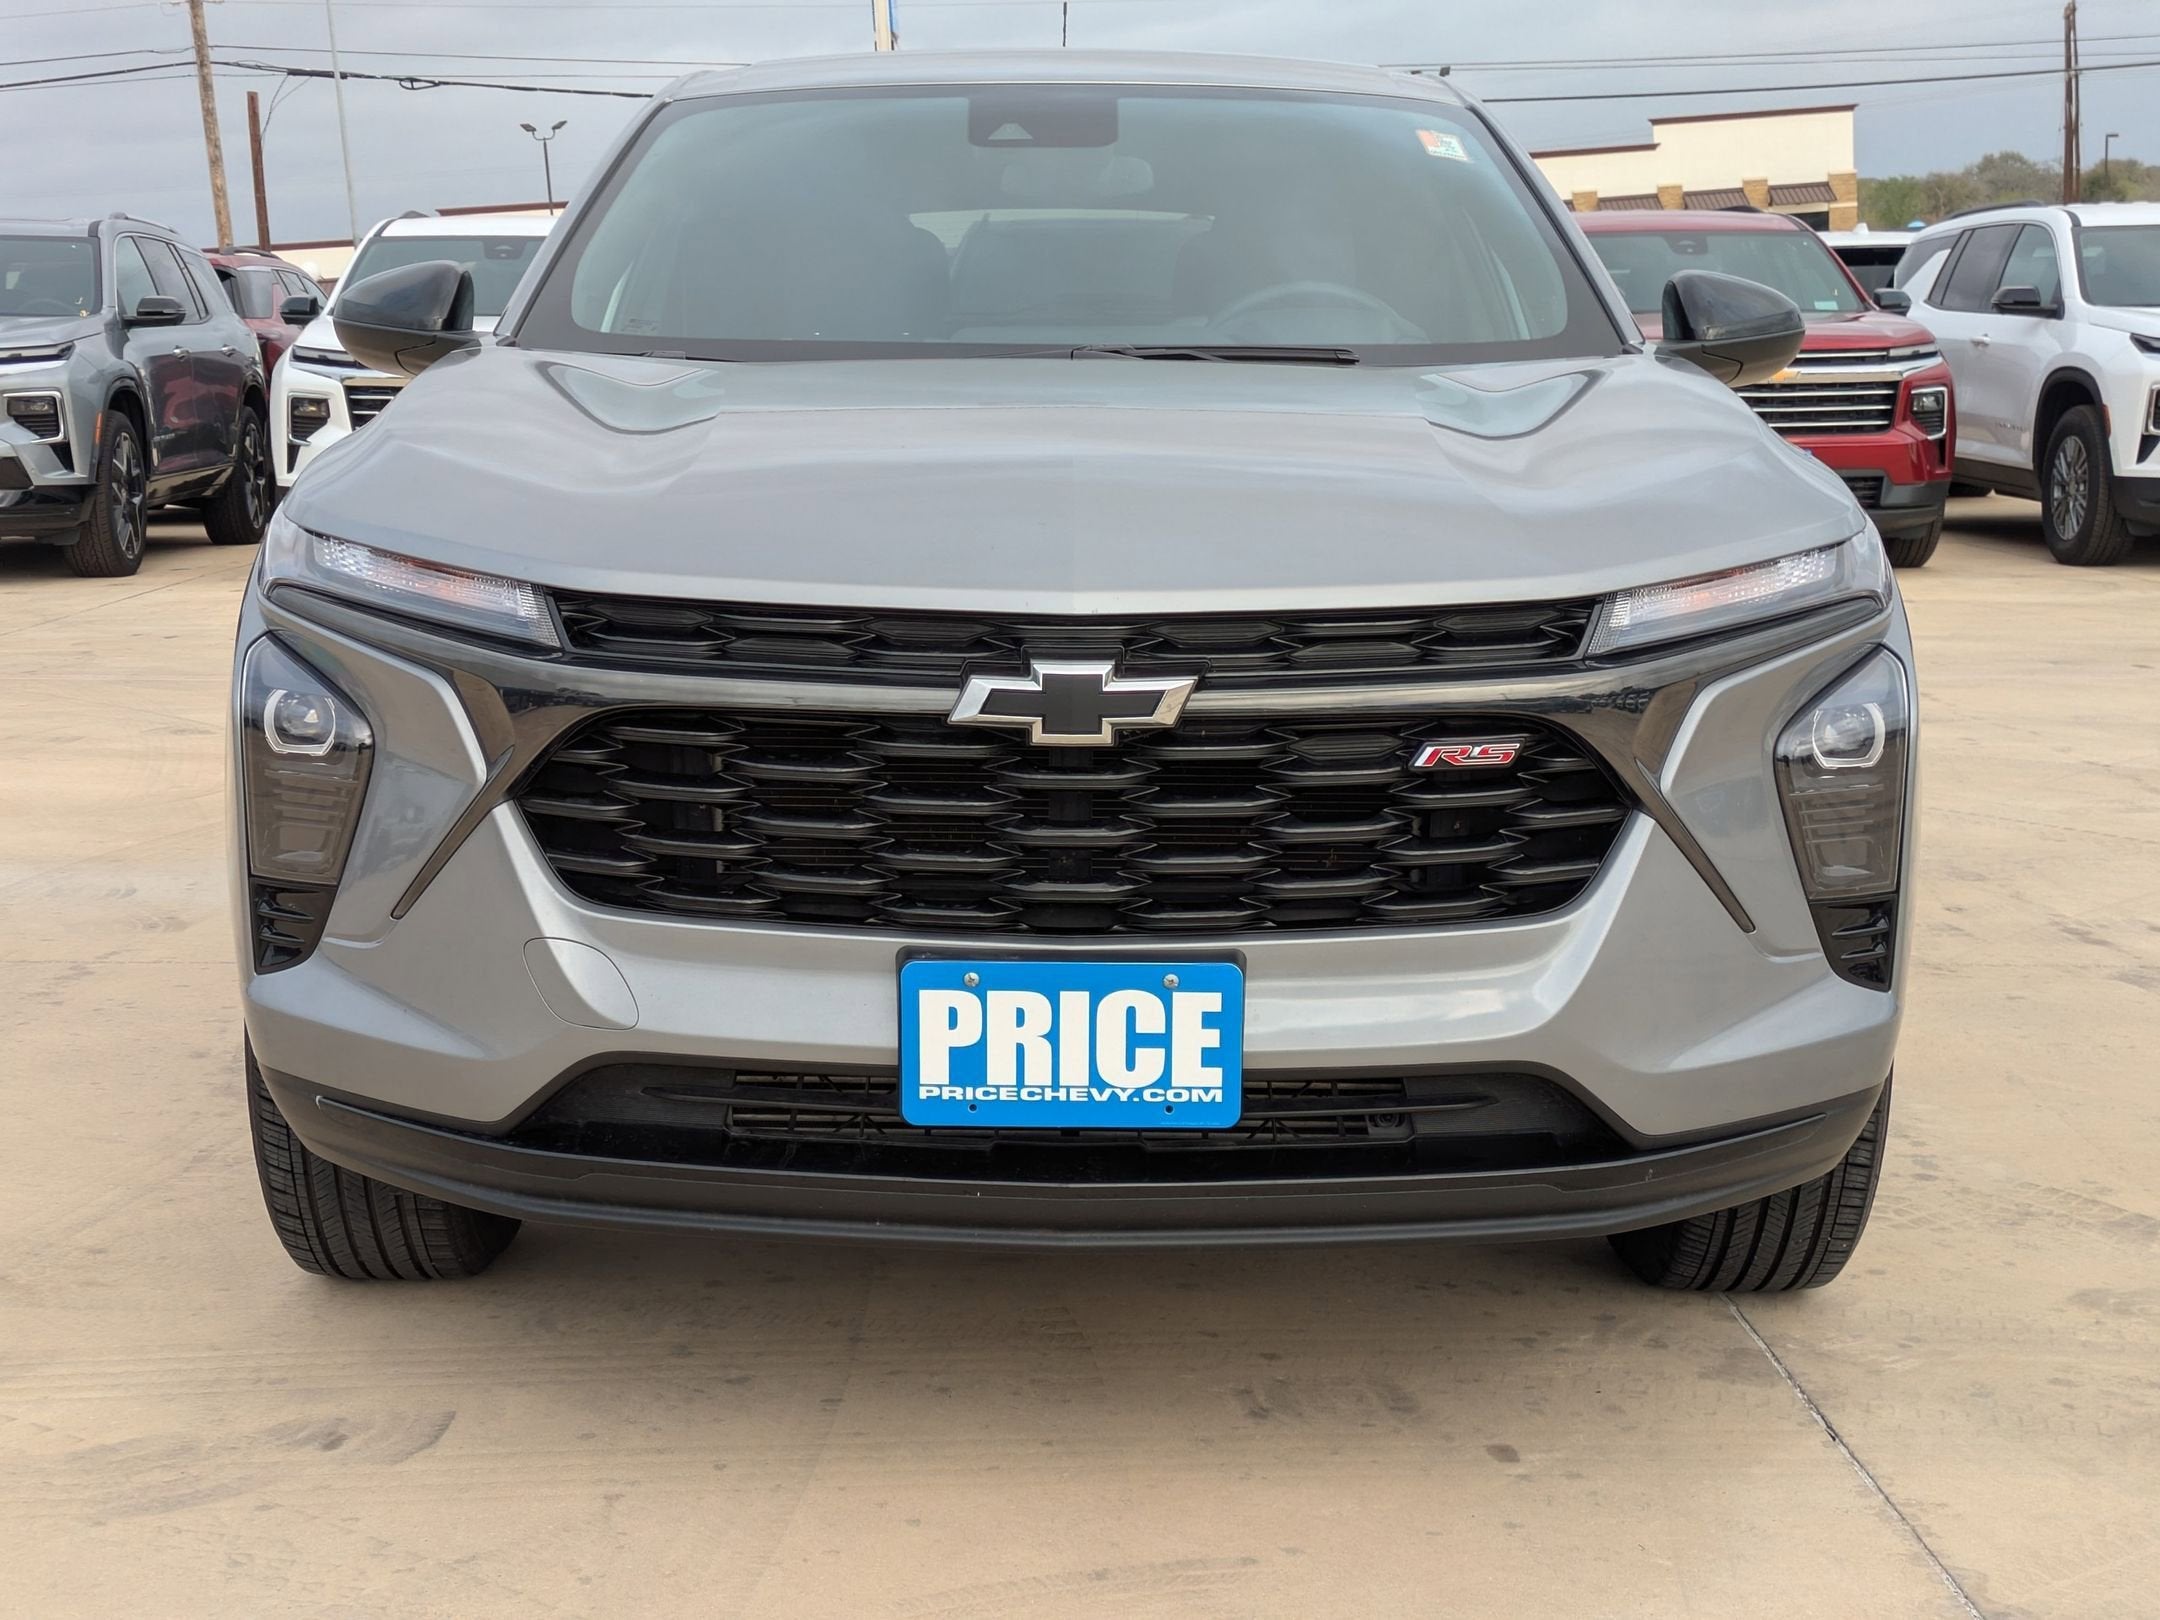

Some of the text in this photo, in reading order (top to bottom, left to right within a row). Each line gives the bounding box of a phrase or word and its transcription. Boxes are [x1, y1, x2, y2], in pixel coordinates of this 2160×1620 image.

[1414, 743, 1520, 767] RS
[919, 989, 1223, 1088] PRICE
[919, 1086, 1223, 1103] PRICECHEVY.COM
